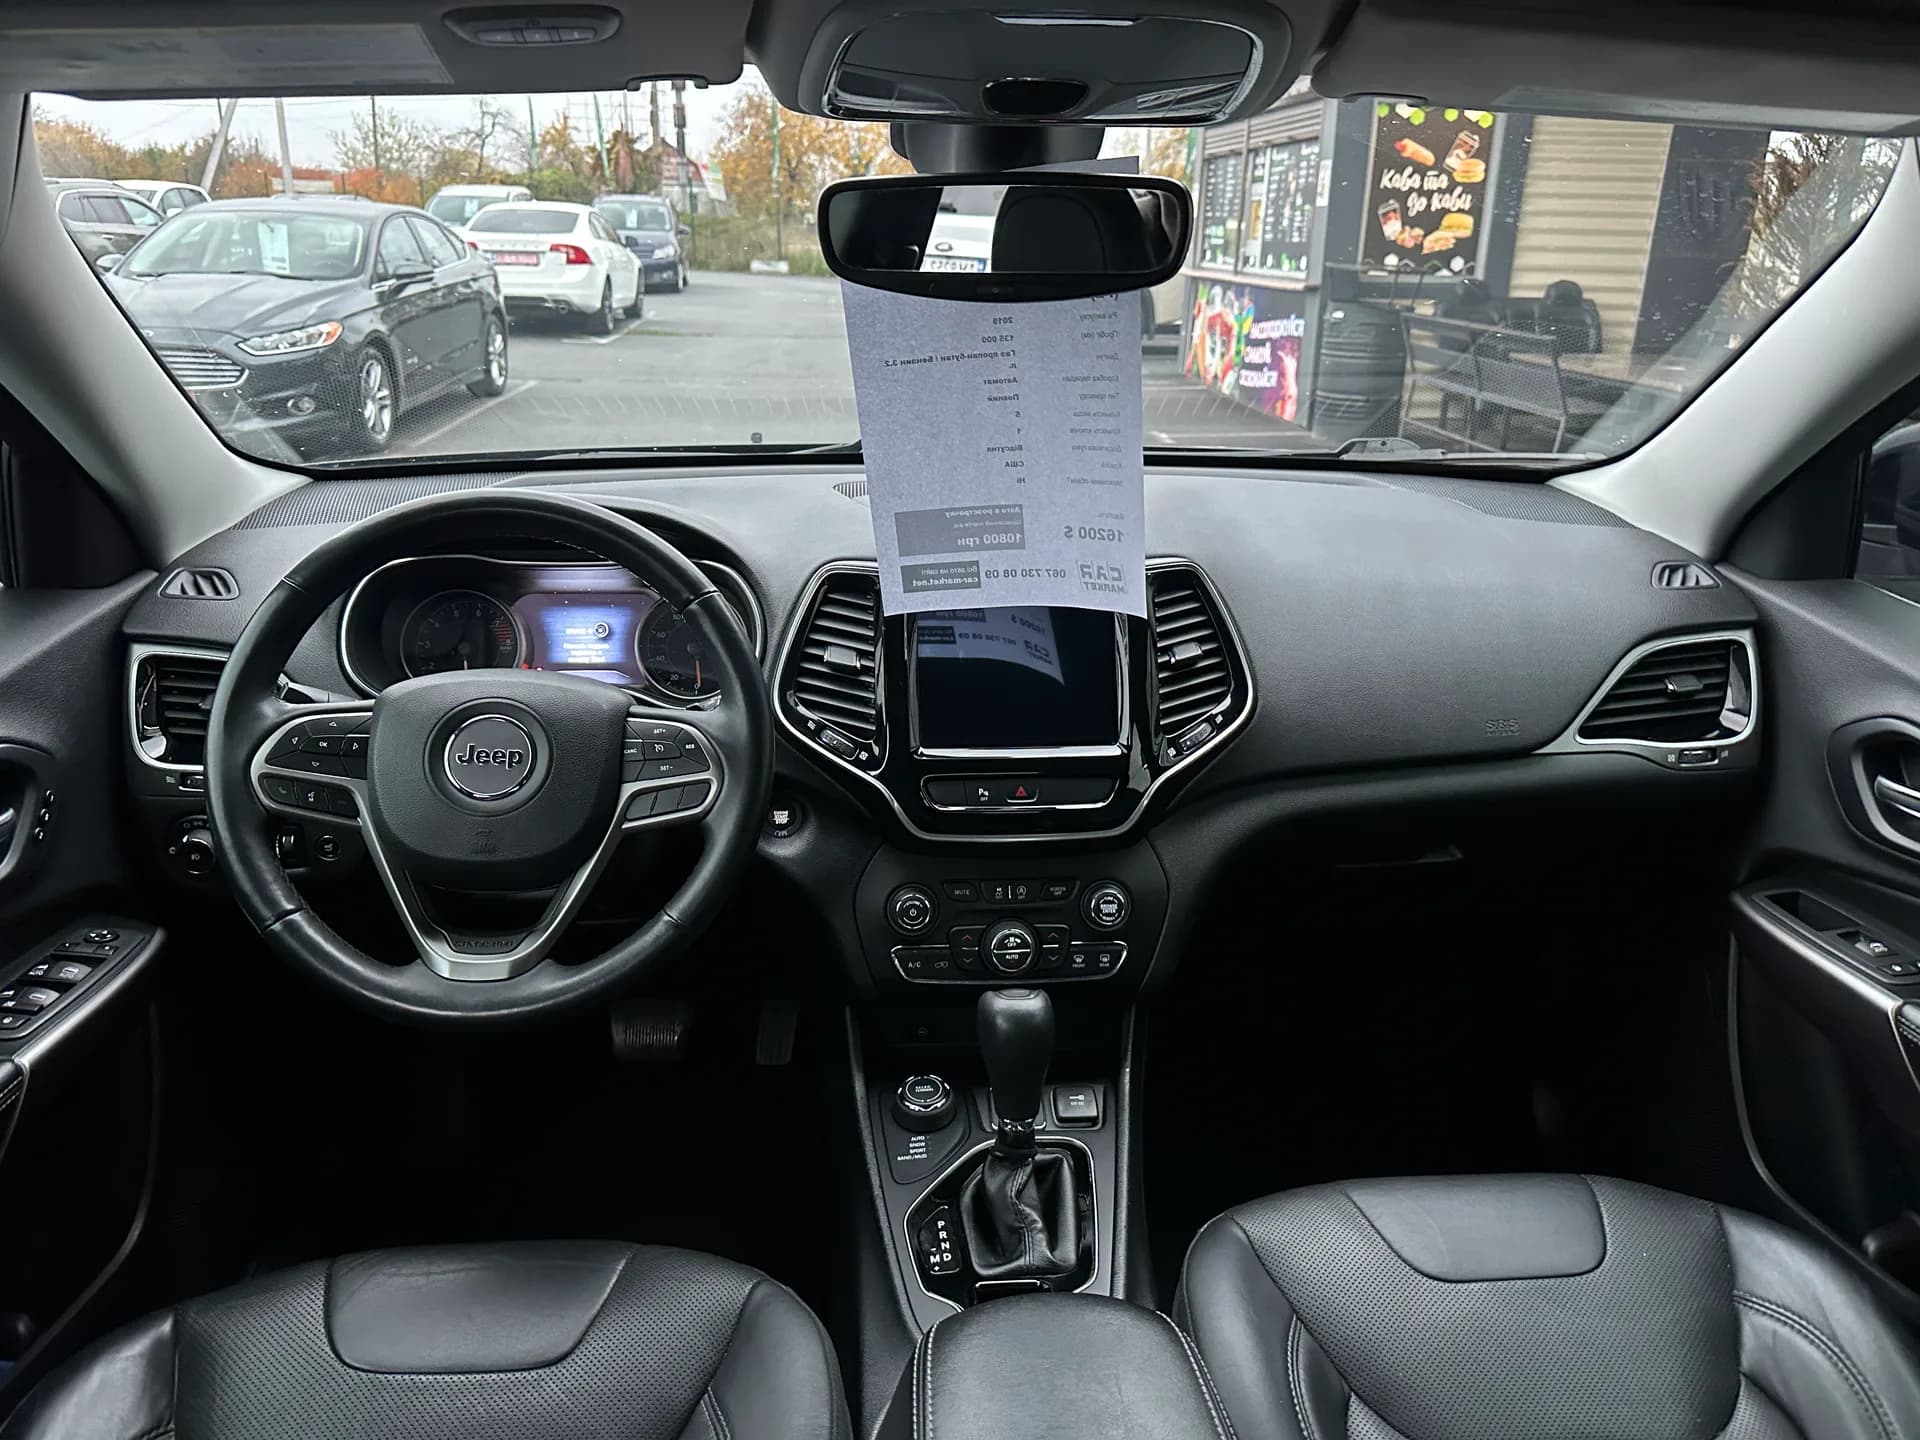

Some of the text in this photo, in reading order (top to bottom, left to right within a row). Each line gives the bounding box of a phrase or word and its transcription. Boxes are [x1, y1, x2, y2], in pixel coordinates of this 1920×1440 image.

[1379, 166, 1449, 192] Кава та
[455, 743, 524, 770] Jeep
[907, 961, 922, 969] A/C
[937, 1220, 946, 1230] P
[938, 1230, 948, 1240] R
[940, 1240, 950, 1251] N
[929, 1253, 941, 1265] M
[942, 1252, 952, 1262] D
